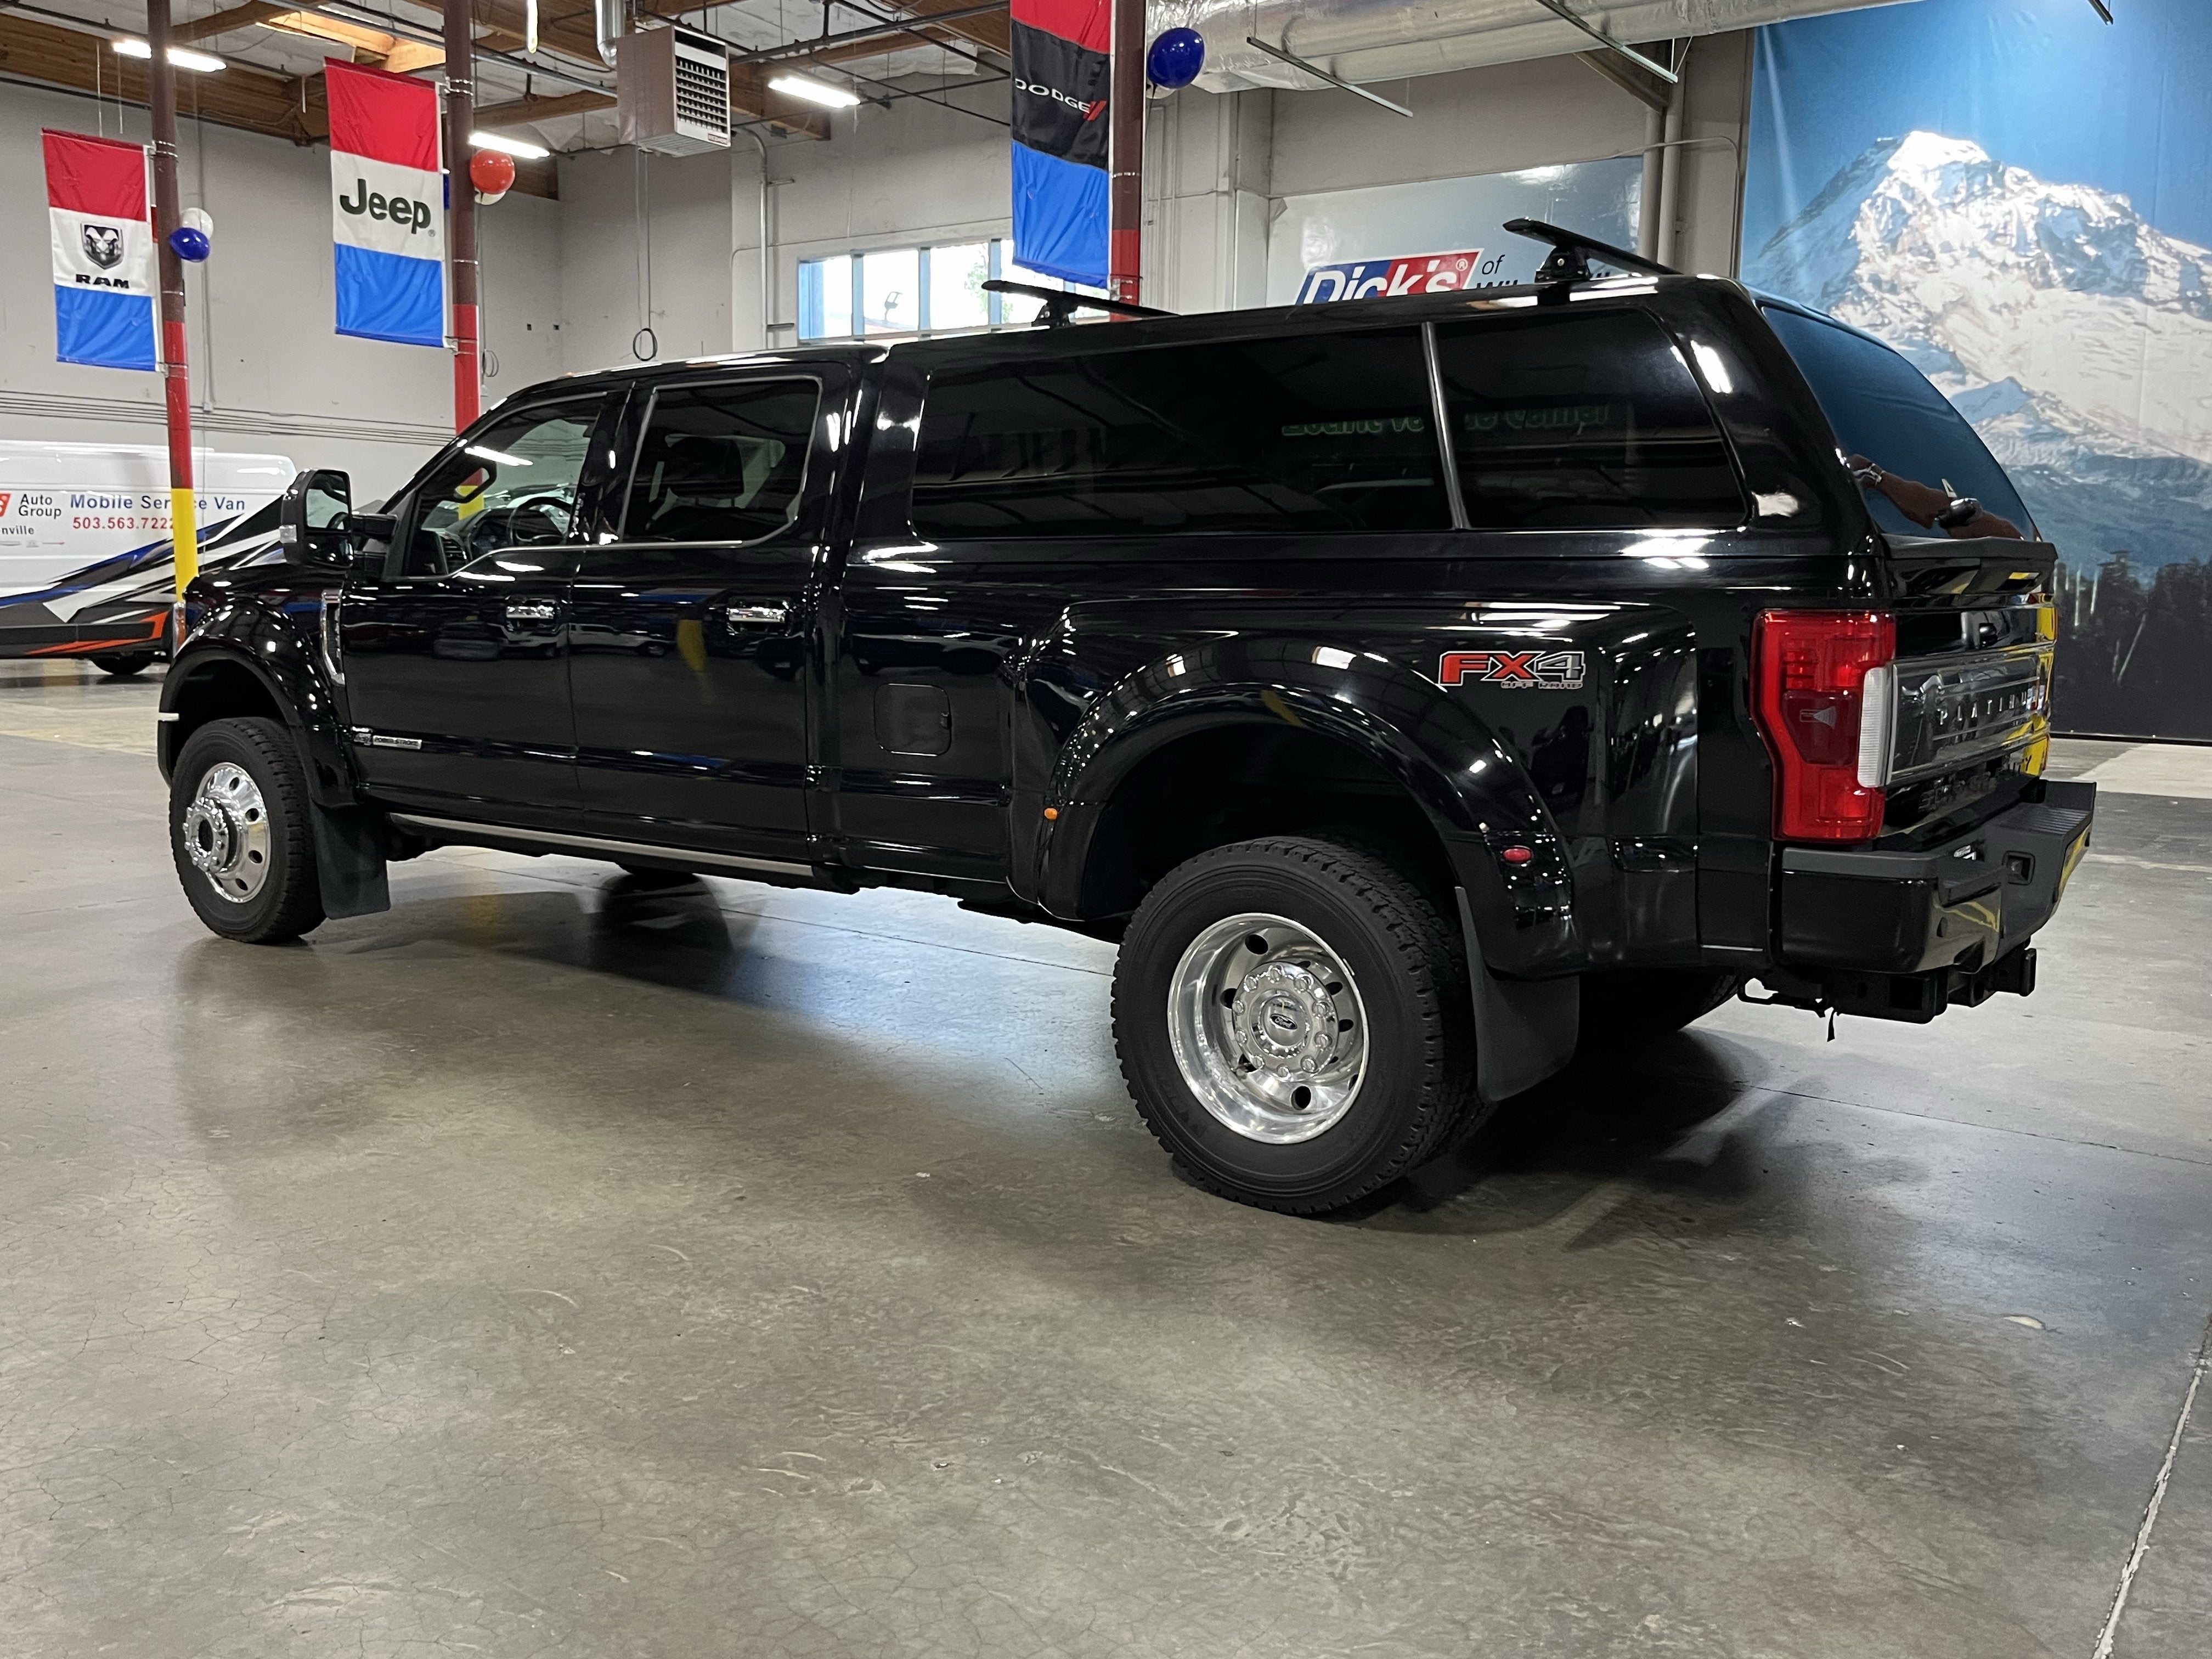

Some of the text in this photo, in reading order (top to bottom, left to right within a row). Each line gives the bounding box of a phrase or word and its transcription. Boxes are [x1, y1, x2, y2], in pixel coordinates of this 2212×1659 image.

[1015, 78, 1090, 114] DODGE
[340, 178, 431, 234] Jeep
[1482, 255, 1505, 275] of
[76, 274, 129, 289] RAM
[1303, 259, 1457, 304] Dick's
[20, 494, 52, 505] Auto
[70, 494, 245, 510] Mobile Sere Van
[19, 505, 61, 519] Group
[0, 526, 34, 534] nville
[1440, 652, 1585, 685] FX4
